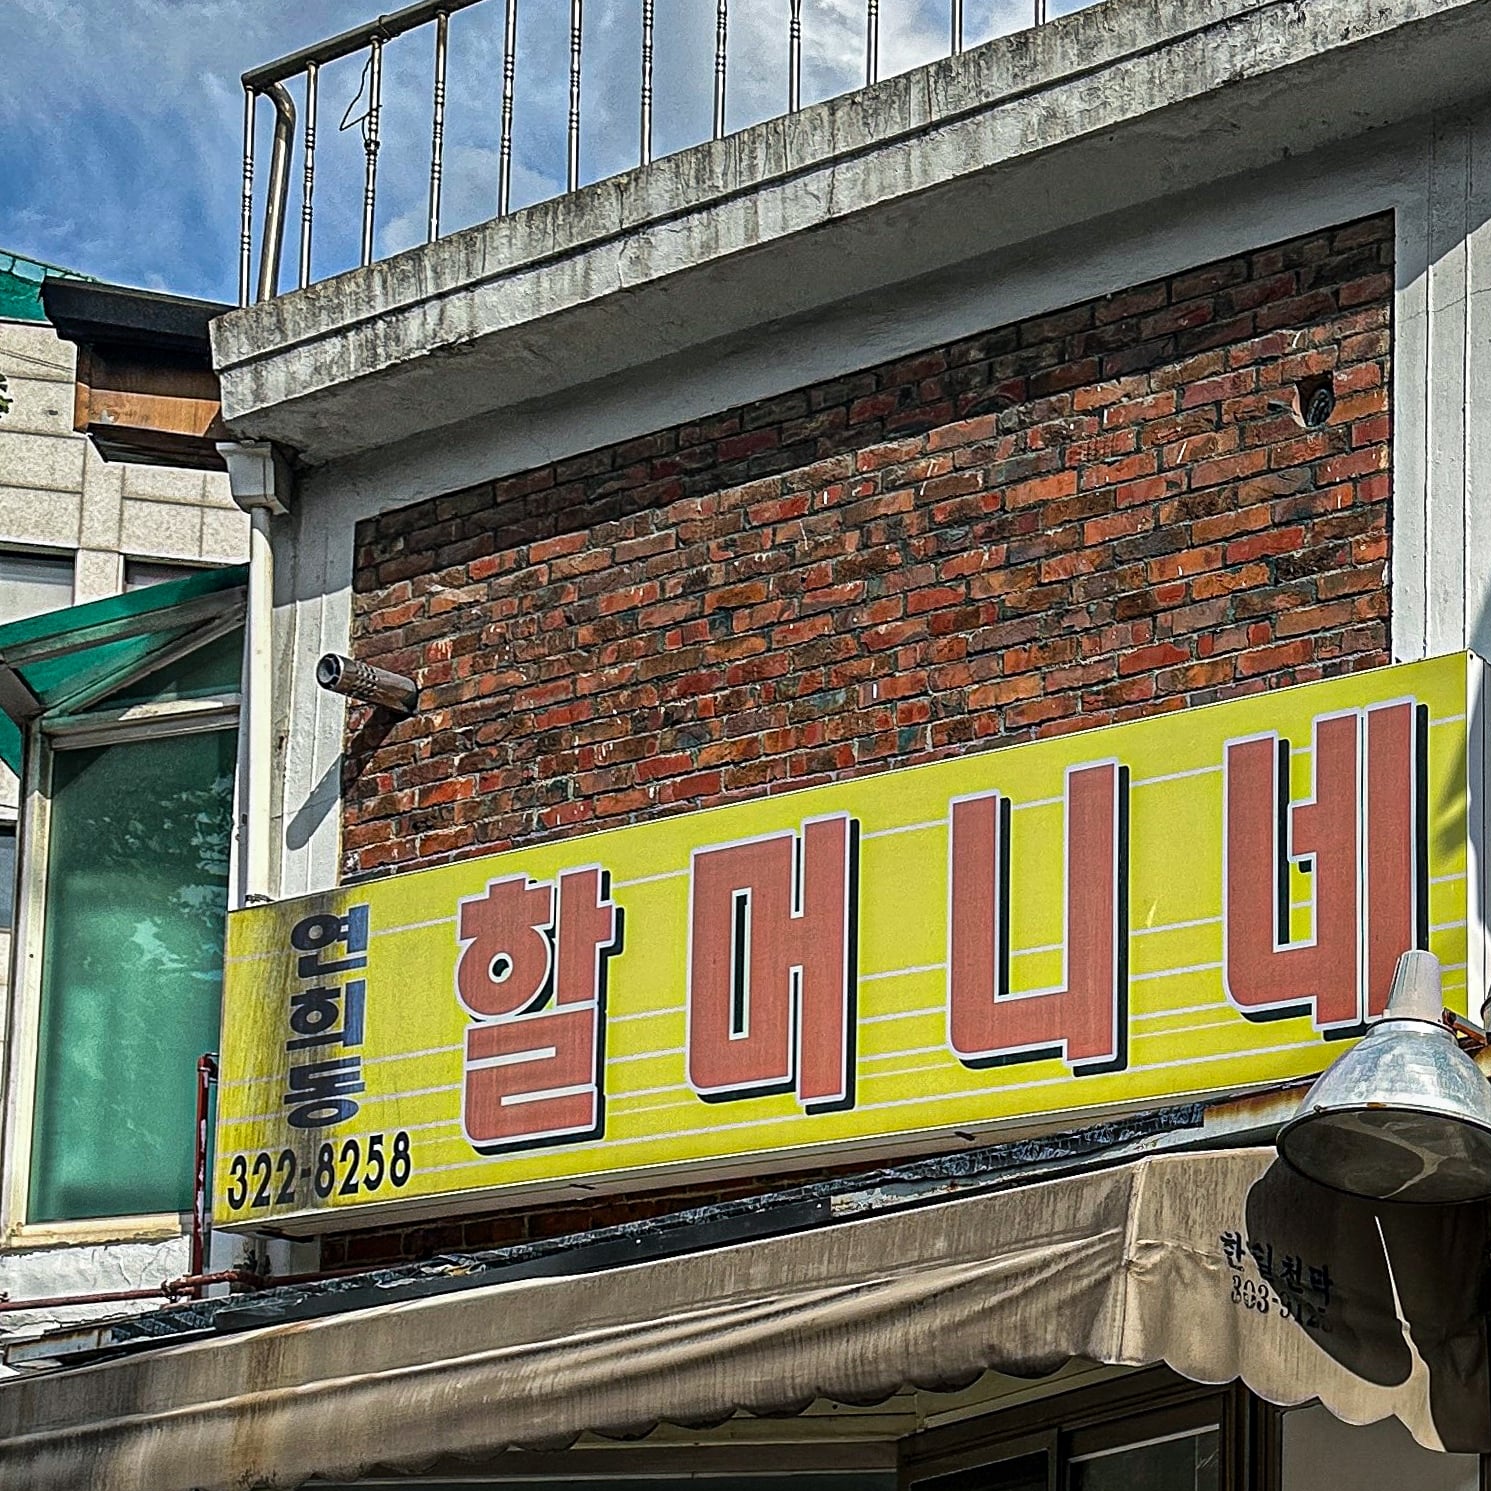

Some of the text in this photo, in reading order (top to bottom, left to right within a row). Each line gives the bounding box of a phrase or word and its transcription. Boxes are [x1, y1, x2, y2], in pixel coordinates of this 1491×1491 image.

[286, 904, 370, 1128] 연희동
[456, 698, 1428, 1155] 할머니네
[227, 1131, 411, 1210] 322-8258
